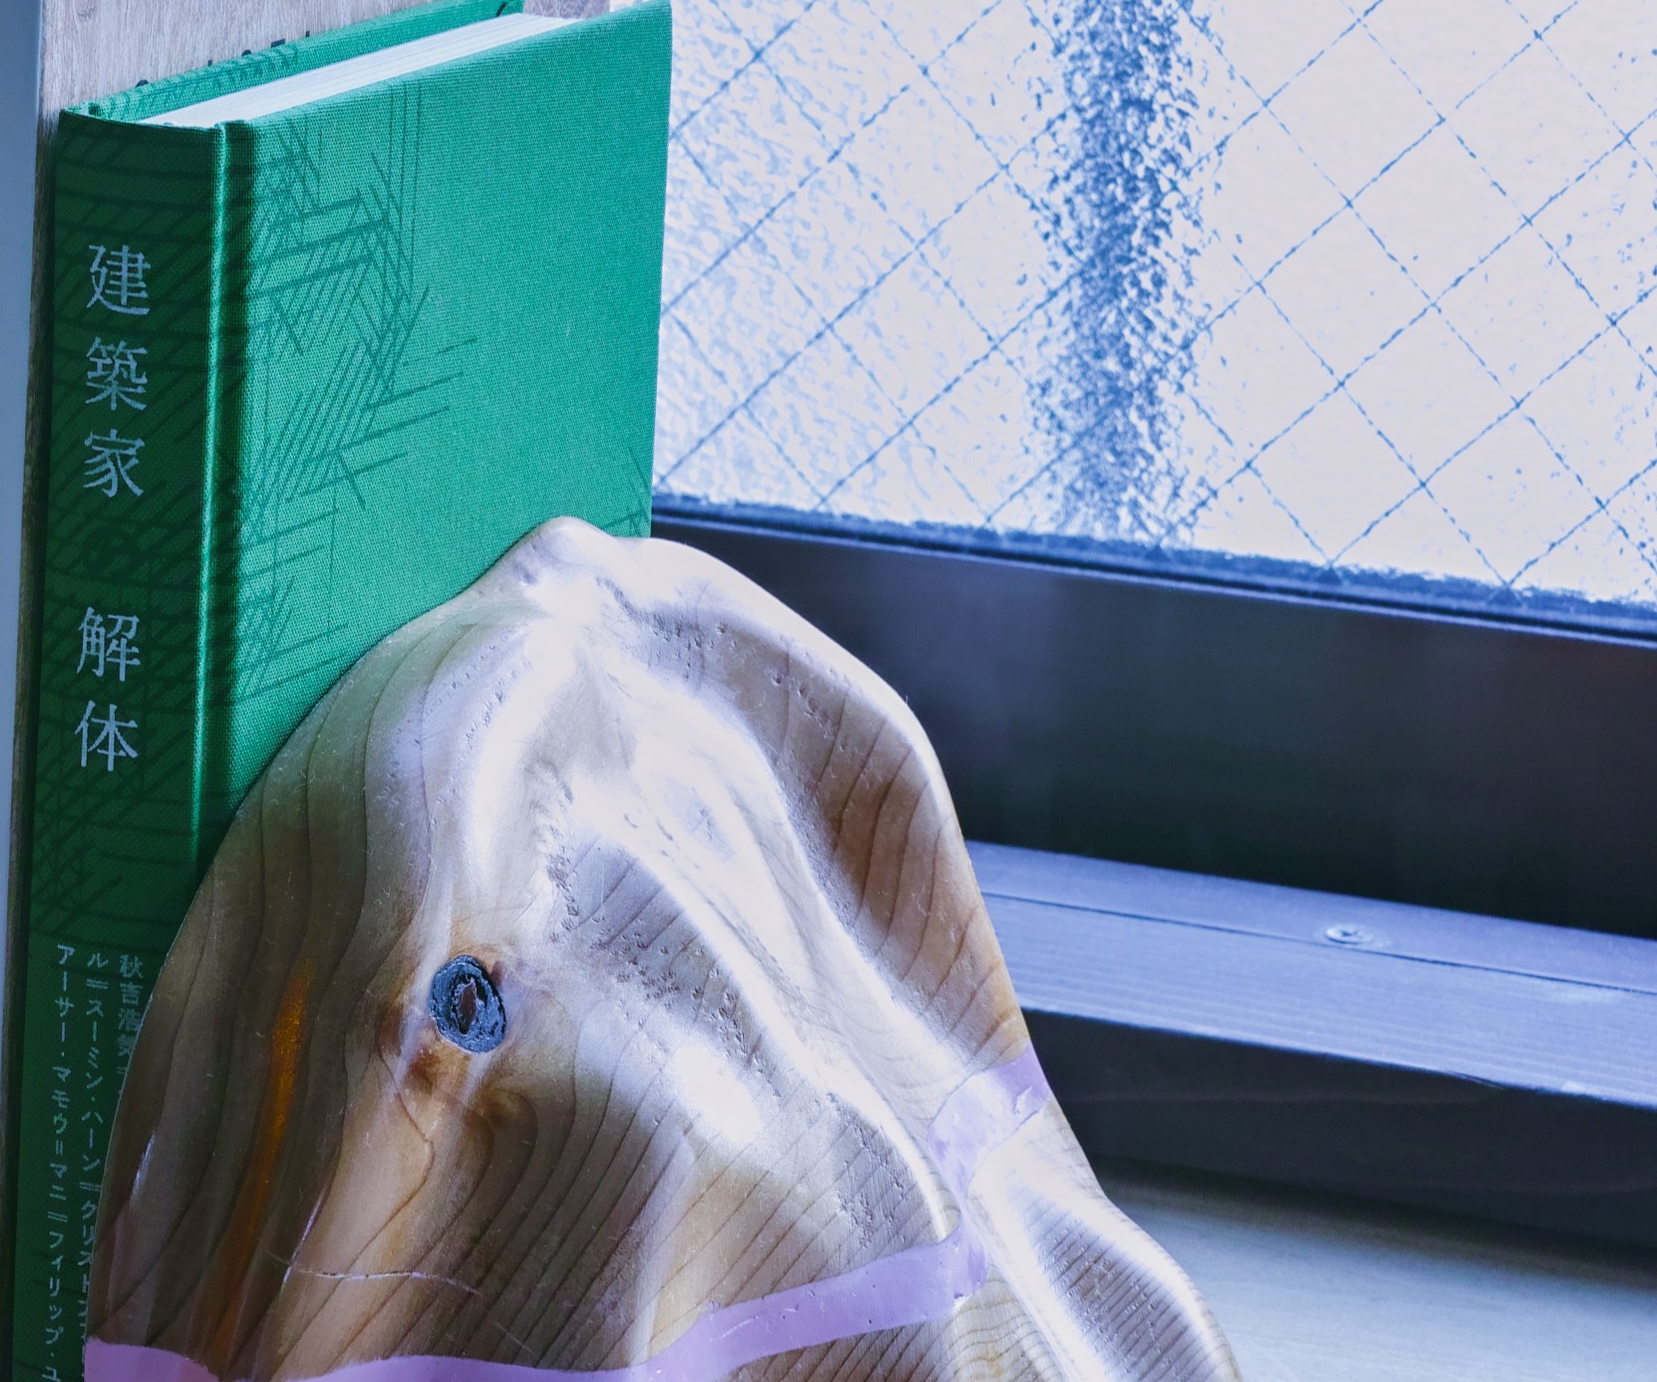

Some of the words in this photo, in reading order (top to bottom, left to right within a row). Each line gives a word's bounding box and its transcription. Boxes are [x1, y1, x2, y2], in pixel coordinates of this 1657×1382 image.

[82, 244, 151, 499] 建築家
[74, 607, 142, 773] 解体
